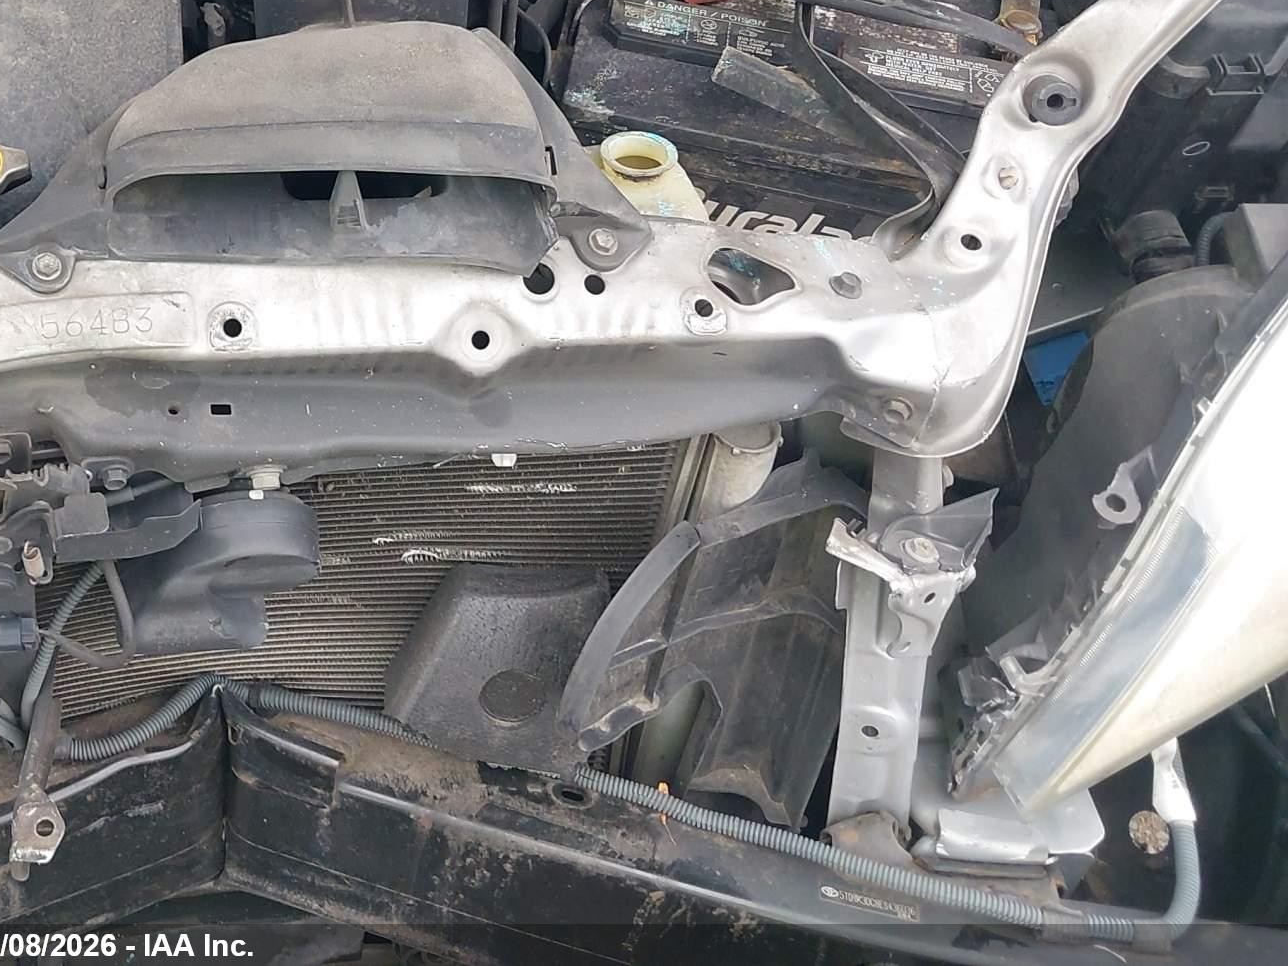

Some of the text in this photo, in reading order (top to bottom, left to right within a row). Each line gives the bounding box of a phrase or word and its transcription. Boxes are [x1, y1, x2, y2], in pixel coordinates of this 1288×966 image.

[657, 1, 708, 16] DANGER
[720, 14, 767, 27] POISON
[40, 307, 153, 339] 56483
